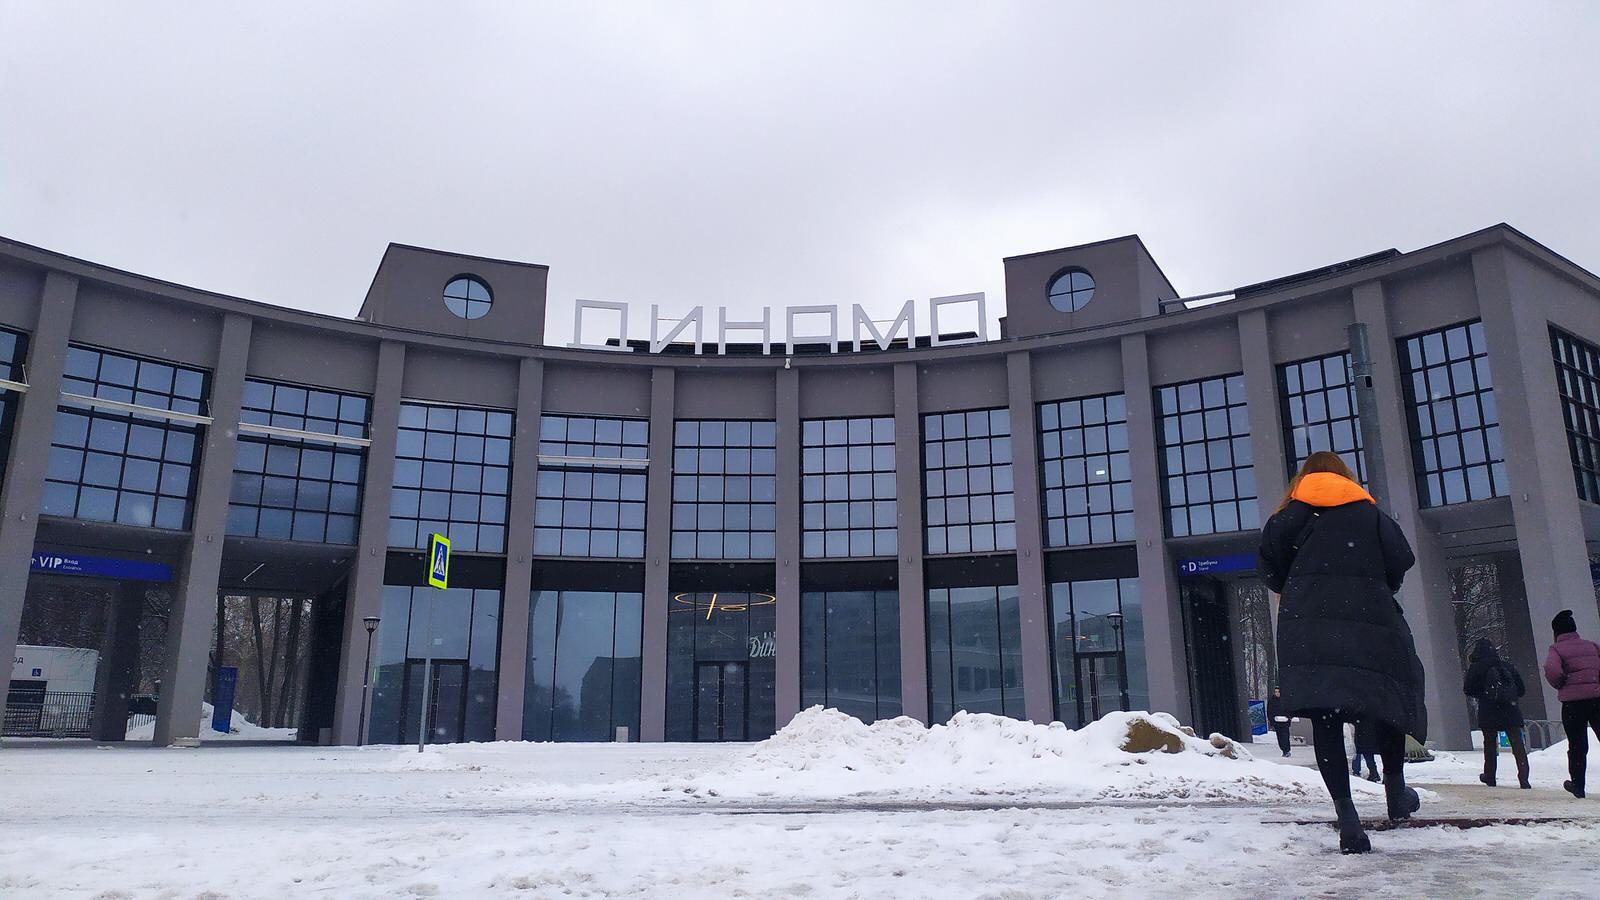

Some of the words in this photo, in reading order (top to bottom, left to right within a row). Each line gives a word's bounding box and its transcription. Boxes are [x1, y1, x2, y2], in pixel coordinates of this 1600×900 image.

[567, 292, 988, 355] ДИНАМО
[40, 556, 62, 568] VIP
[1189, 562, 1196, 571] D
